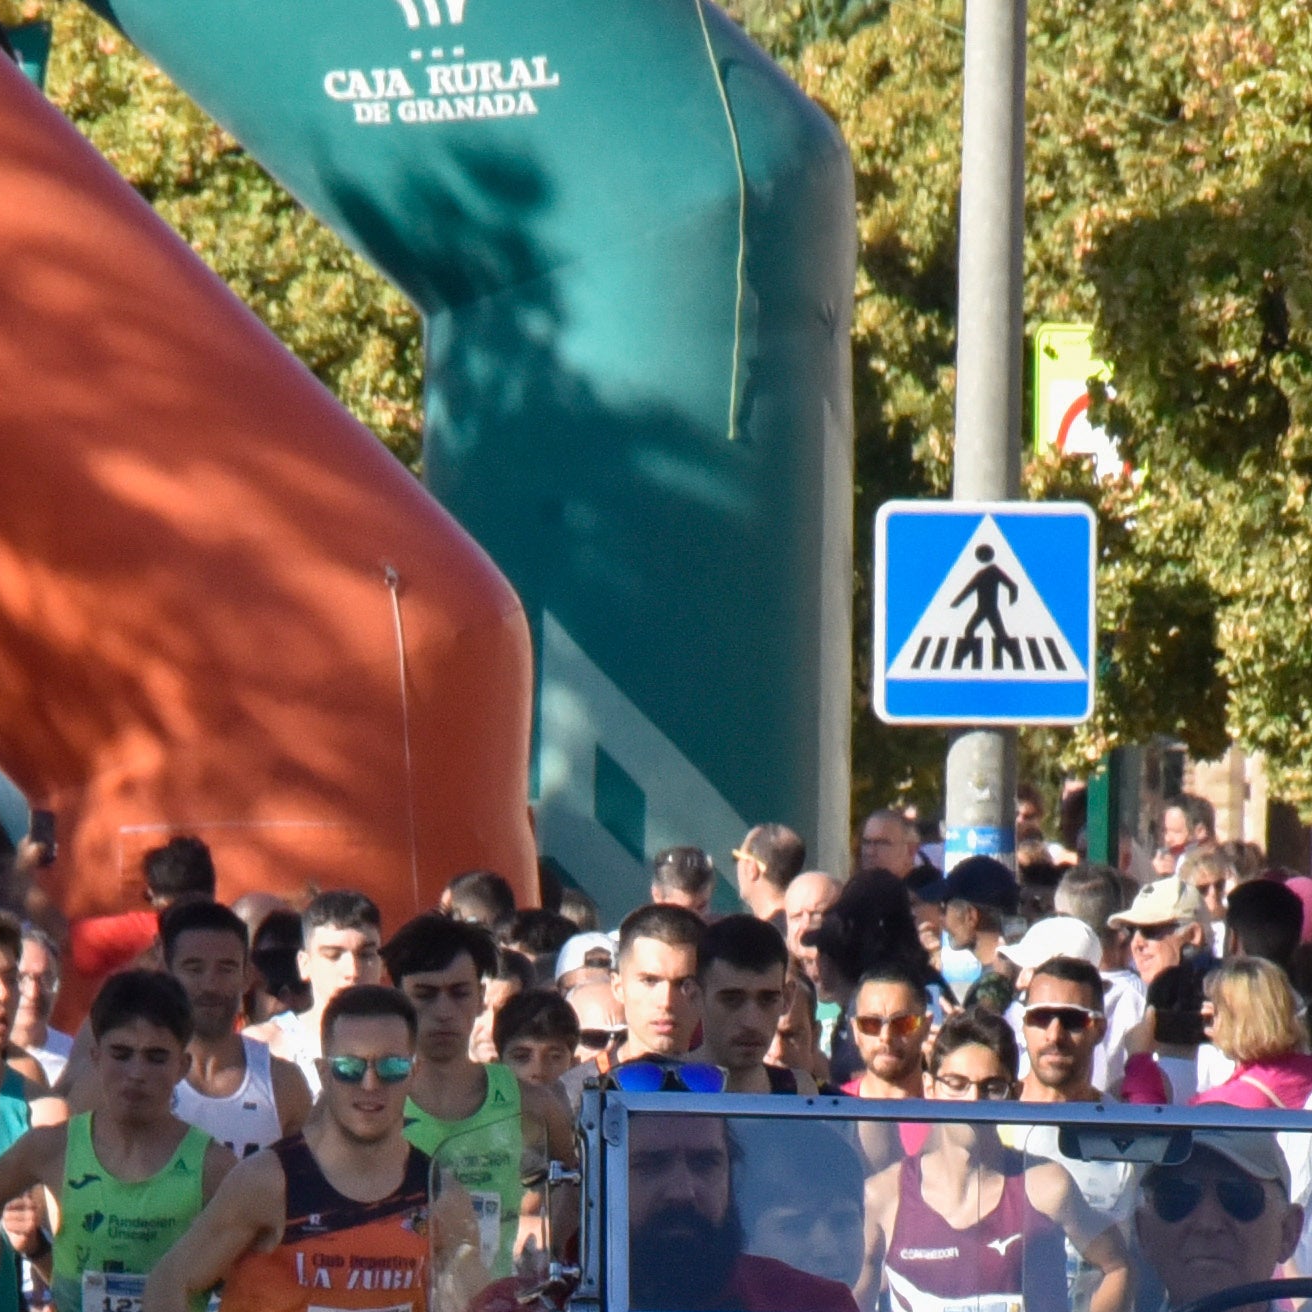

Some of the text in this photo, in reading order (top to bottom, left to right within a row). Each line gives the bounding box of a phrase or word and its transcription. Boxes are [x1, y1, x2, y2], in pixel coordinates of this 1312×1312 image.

[324, 54, 560, 100] CAJA RURAL
[353, 91, 538, 124] DE GRANADA
